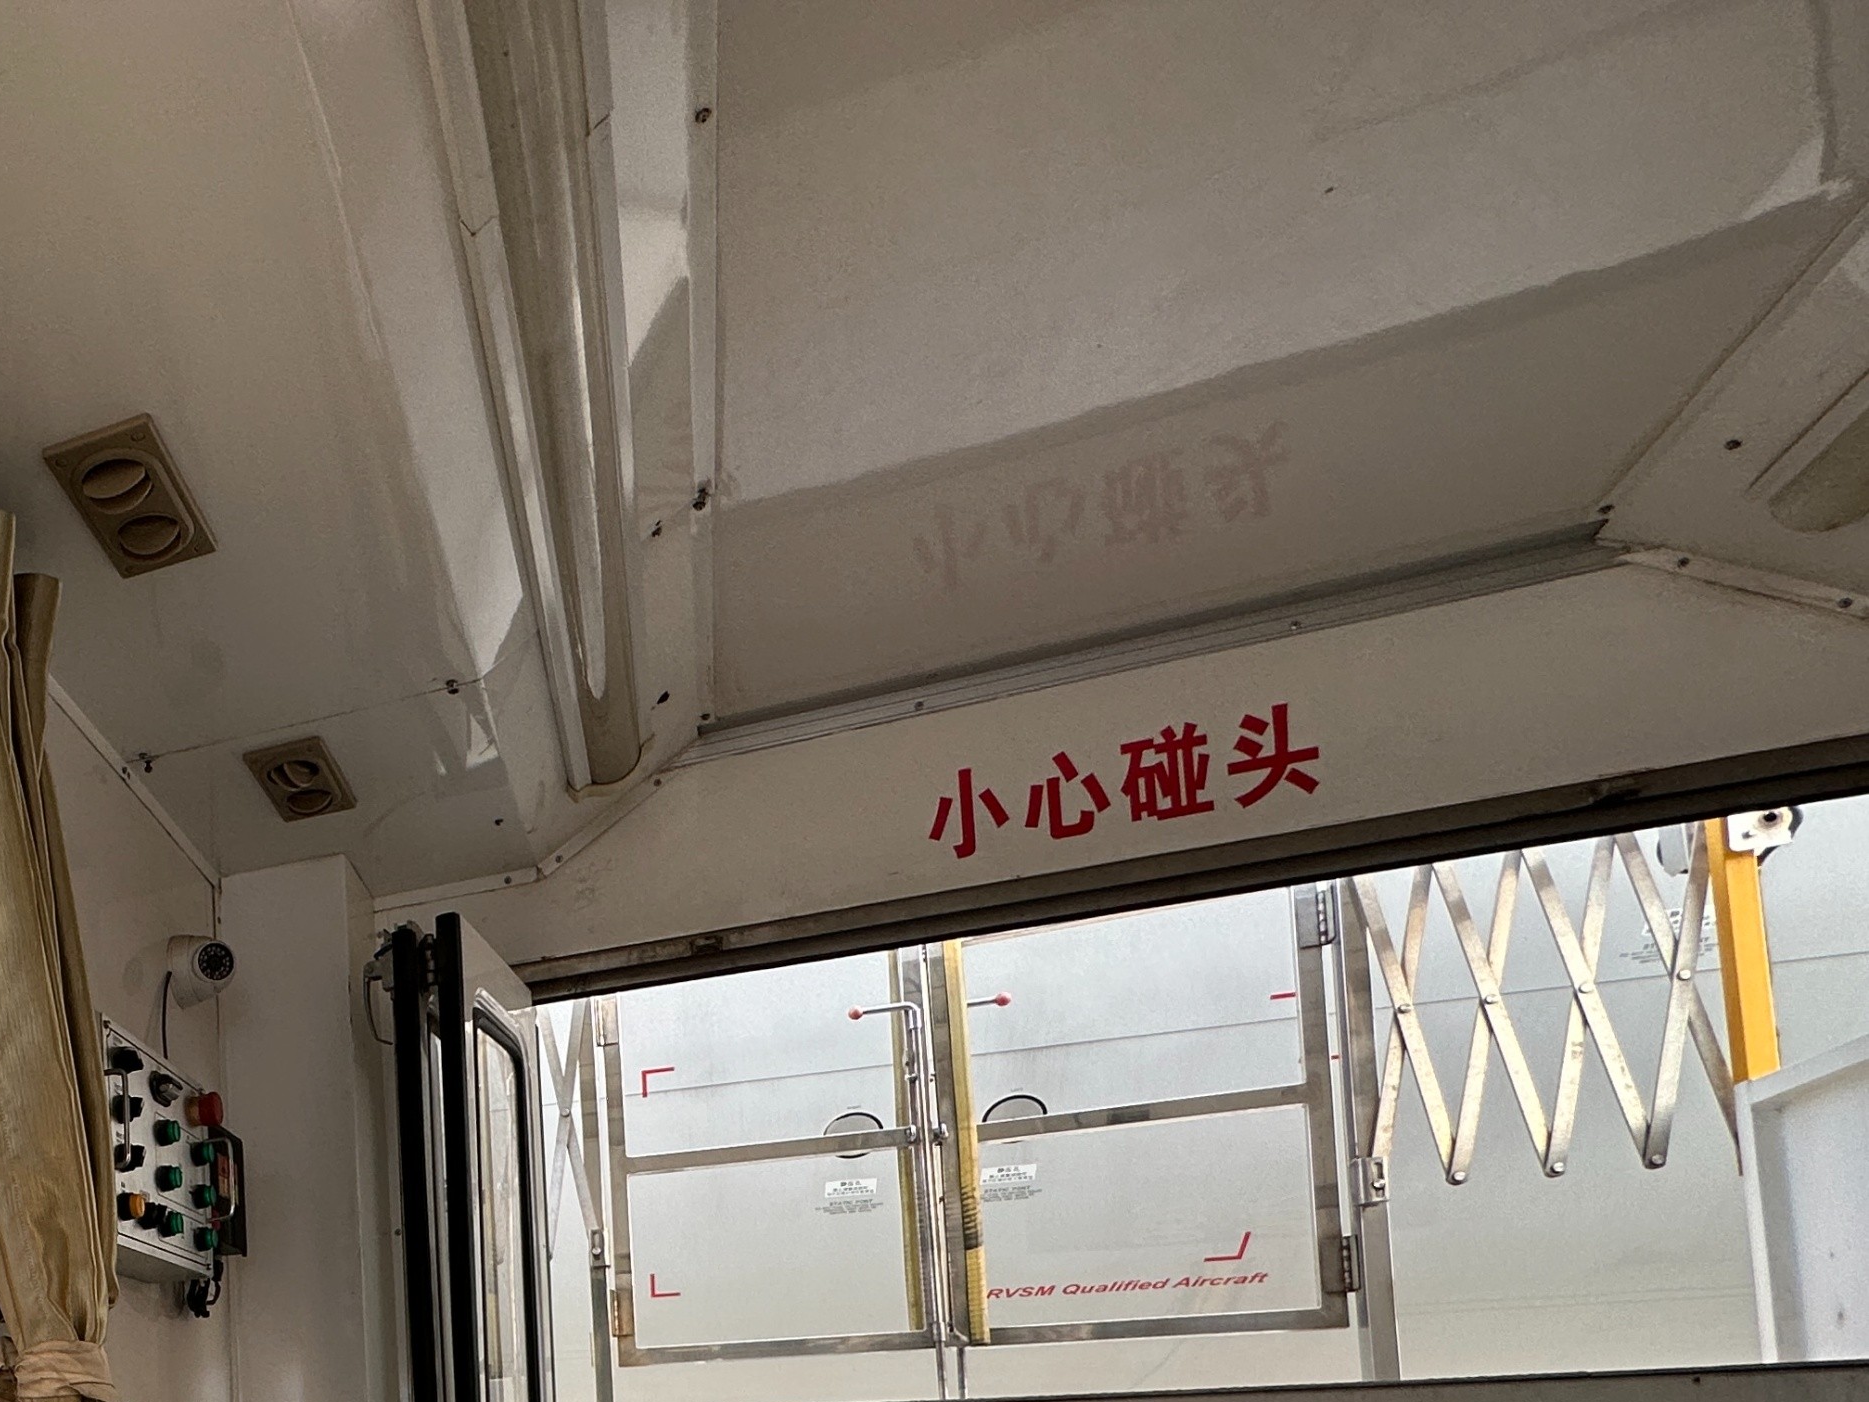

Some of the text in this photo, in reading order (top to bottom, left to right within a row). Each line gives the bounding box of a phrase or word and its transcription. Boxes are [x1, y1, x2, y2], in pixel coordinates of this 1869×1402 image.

[928, 702, 1321, 859] 小心碰头
[986, 1271, 1269, 1299] RVSM Qualified Aircraft
